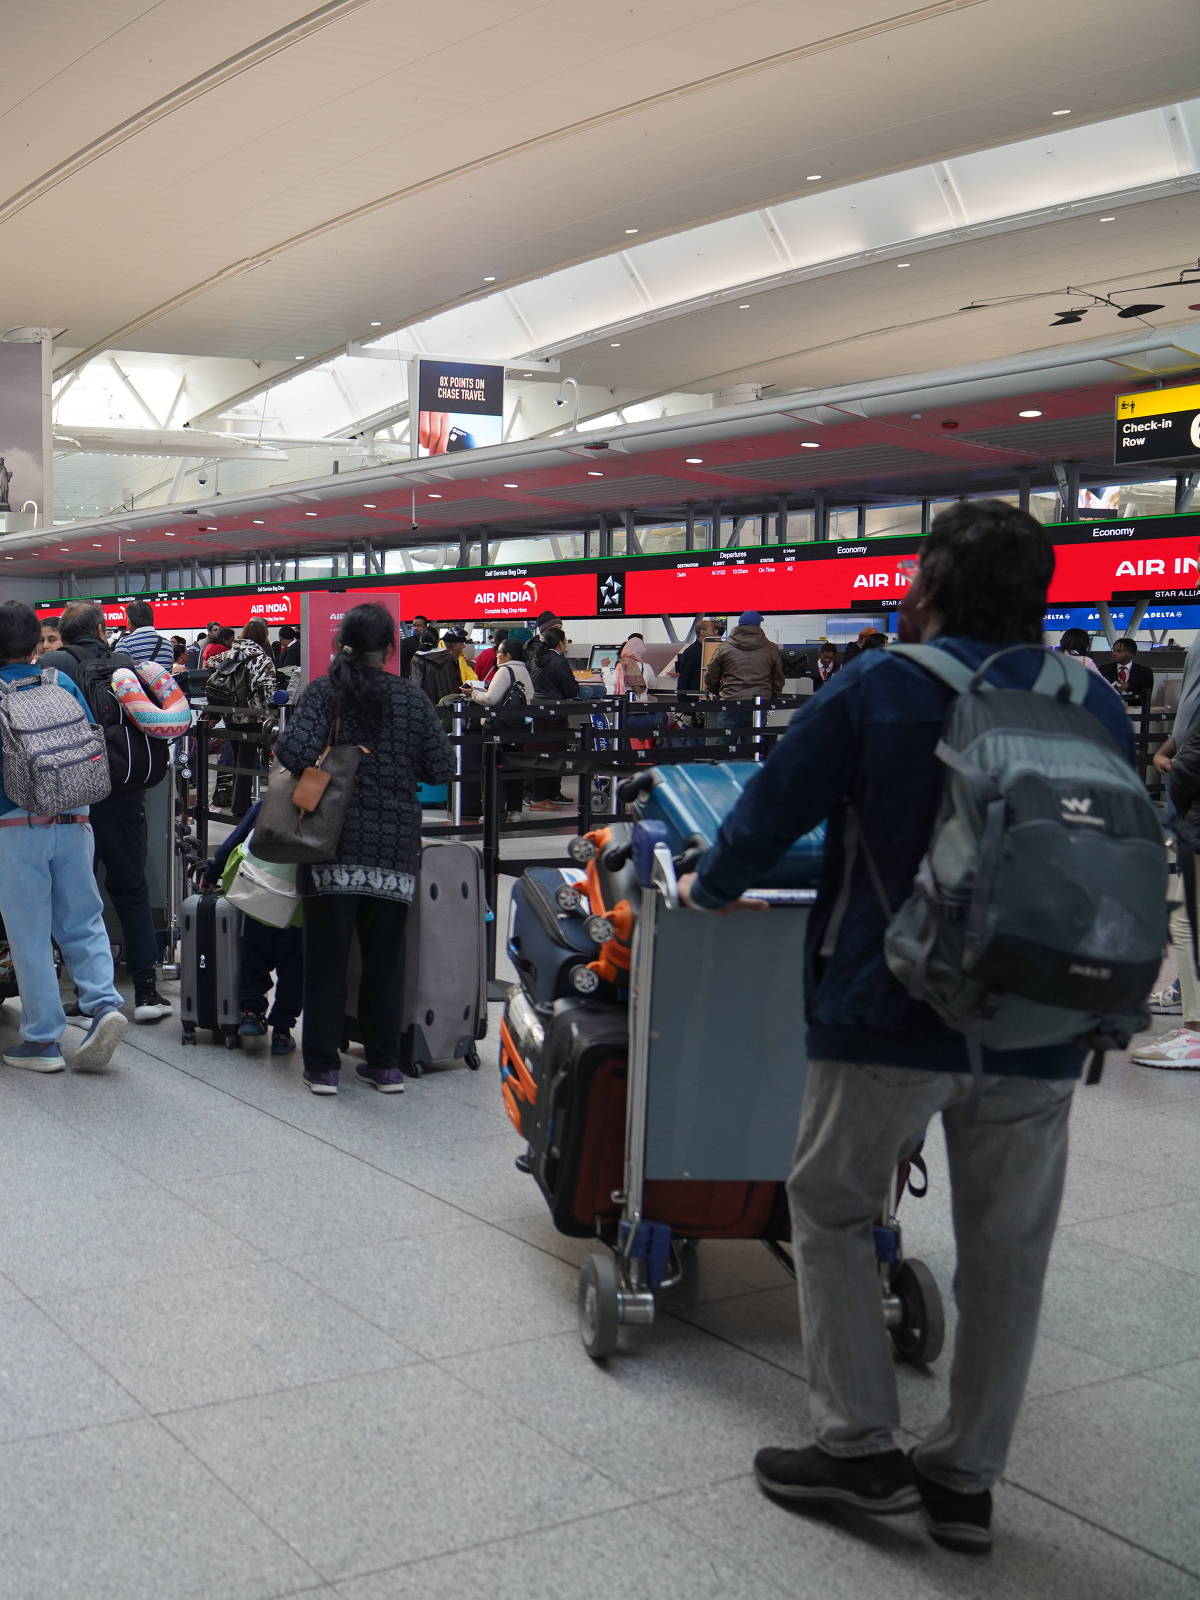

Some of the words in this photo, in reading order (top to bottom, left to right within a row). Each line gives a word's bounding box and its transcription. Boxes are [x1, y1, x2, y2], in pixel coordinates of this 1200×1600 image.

[440, 376, 448, 386] 8X
[450, 377, 473, 388] POINTS
[476, 379, 484, 389] ON
[438, 388, 460, 399] CHASE
[461, 389, 486, 401] TRAVEL
[1122, 419, 1172, 434] Check-in
[1122, 438, 1146, 447] Row
[1093, 528, 1135, 537] Economy
[837, 546, 867, 554] Economy
[1116, 559, 1165, 576] AIR
[854, 573, 888, 588] AIR
[474, 593, 495, 603] AIR
[498, 591, 531, 602] INDIA
[251, 604, 264, 613] AIR
[266, 603, 287, 612] INDIA
